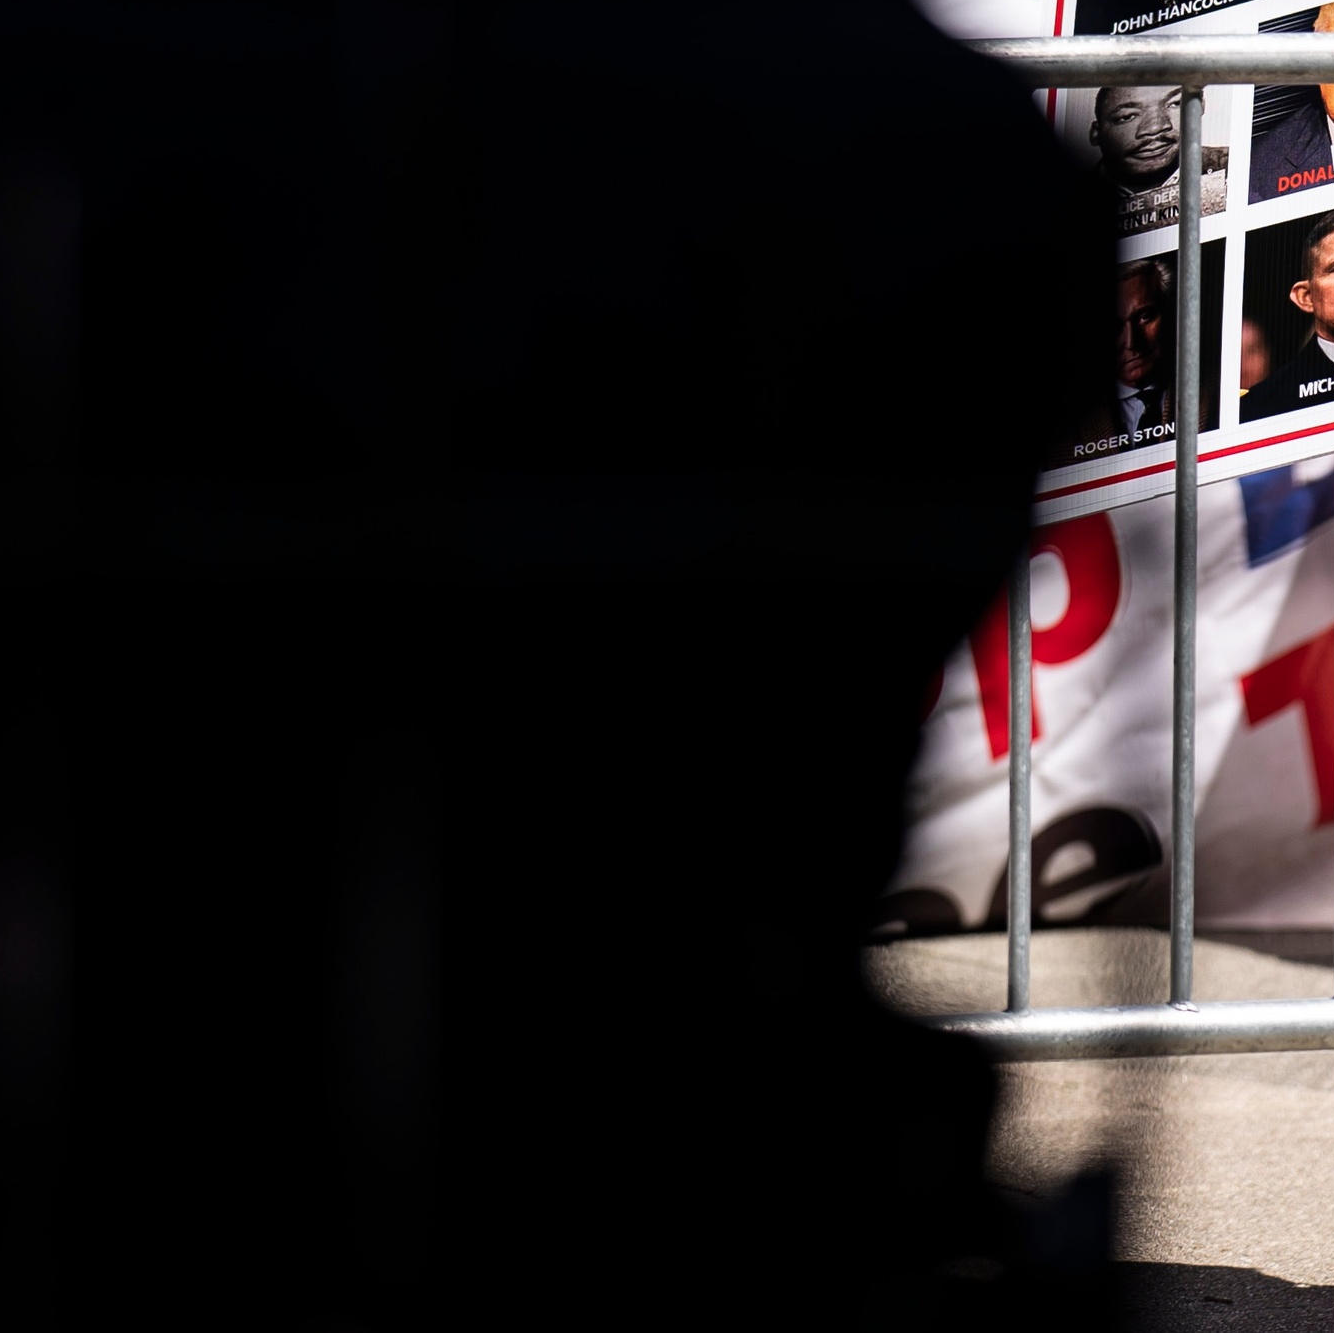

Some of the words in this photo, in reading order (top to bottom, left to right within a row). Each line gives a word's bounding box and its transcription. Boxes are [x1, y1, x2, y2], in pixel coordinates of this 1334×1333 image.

[1110, 12, 1154, 36] JOHN
[1153, 189, 1180, 205] DEP
[1073, 433, 1130, 457] ROGER
[1133, 421, 1177, 443] STON
